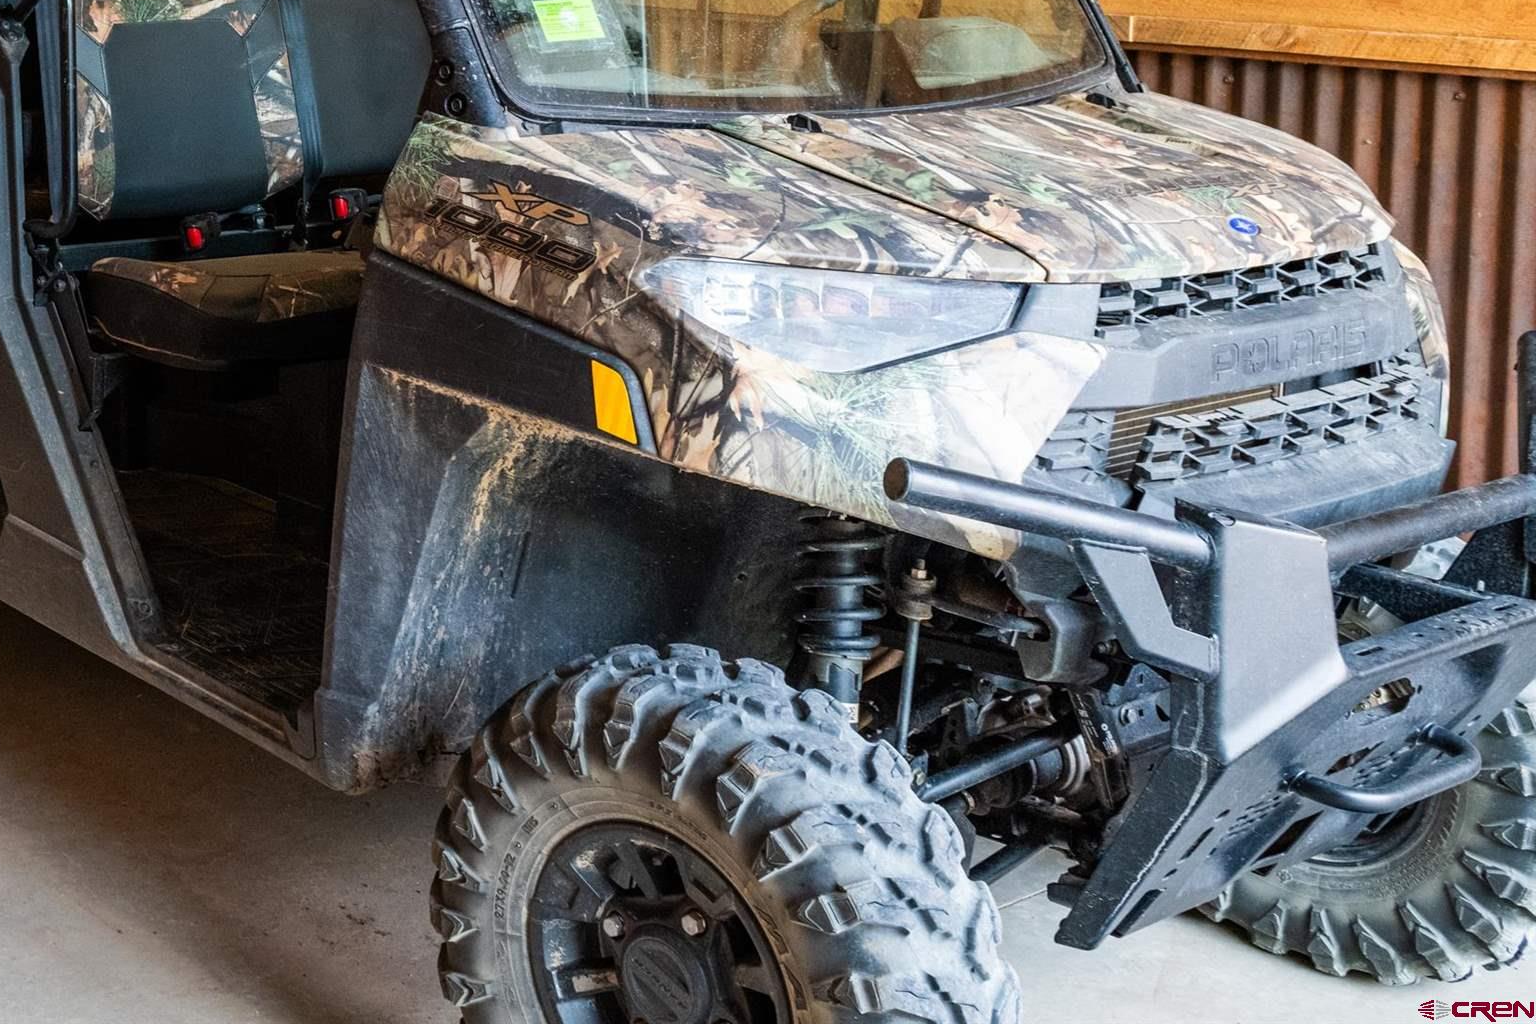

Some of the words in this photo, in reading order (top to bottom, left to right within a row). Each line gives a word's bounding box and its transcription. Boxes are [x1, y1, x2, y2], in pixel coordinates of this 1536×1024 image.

[459, 178, 591, 226] XP
[423, 197, 597, 274] 1000
[1213, 321, 1367, 382] POLARIS
